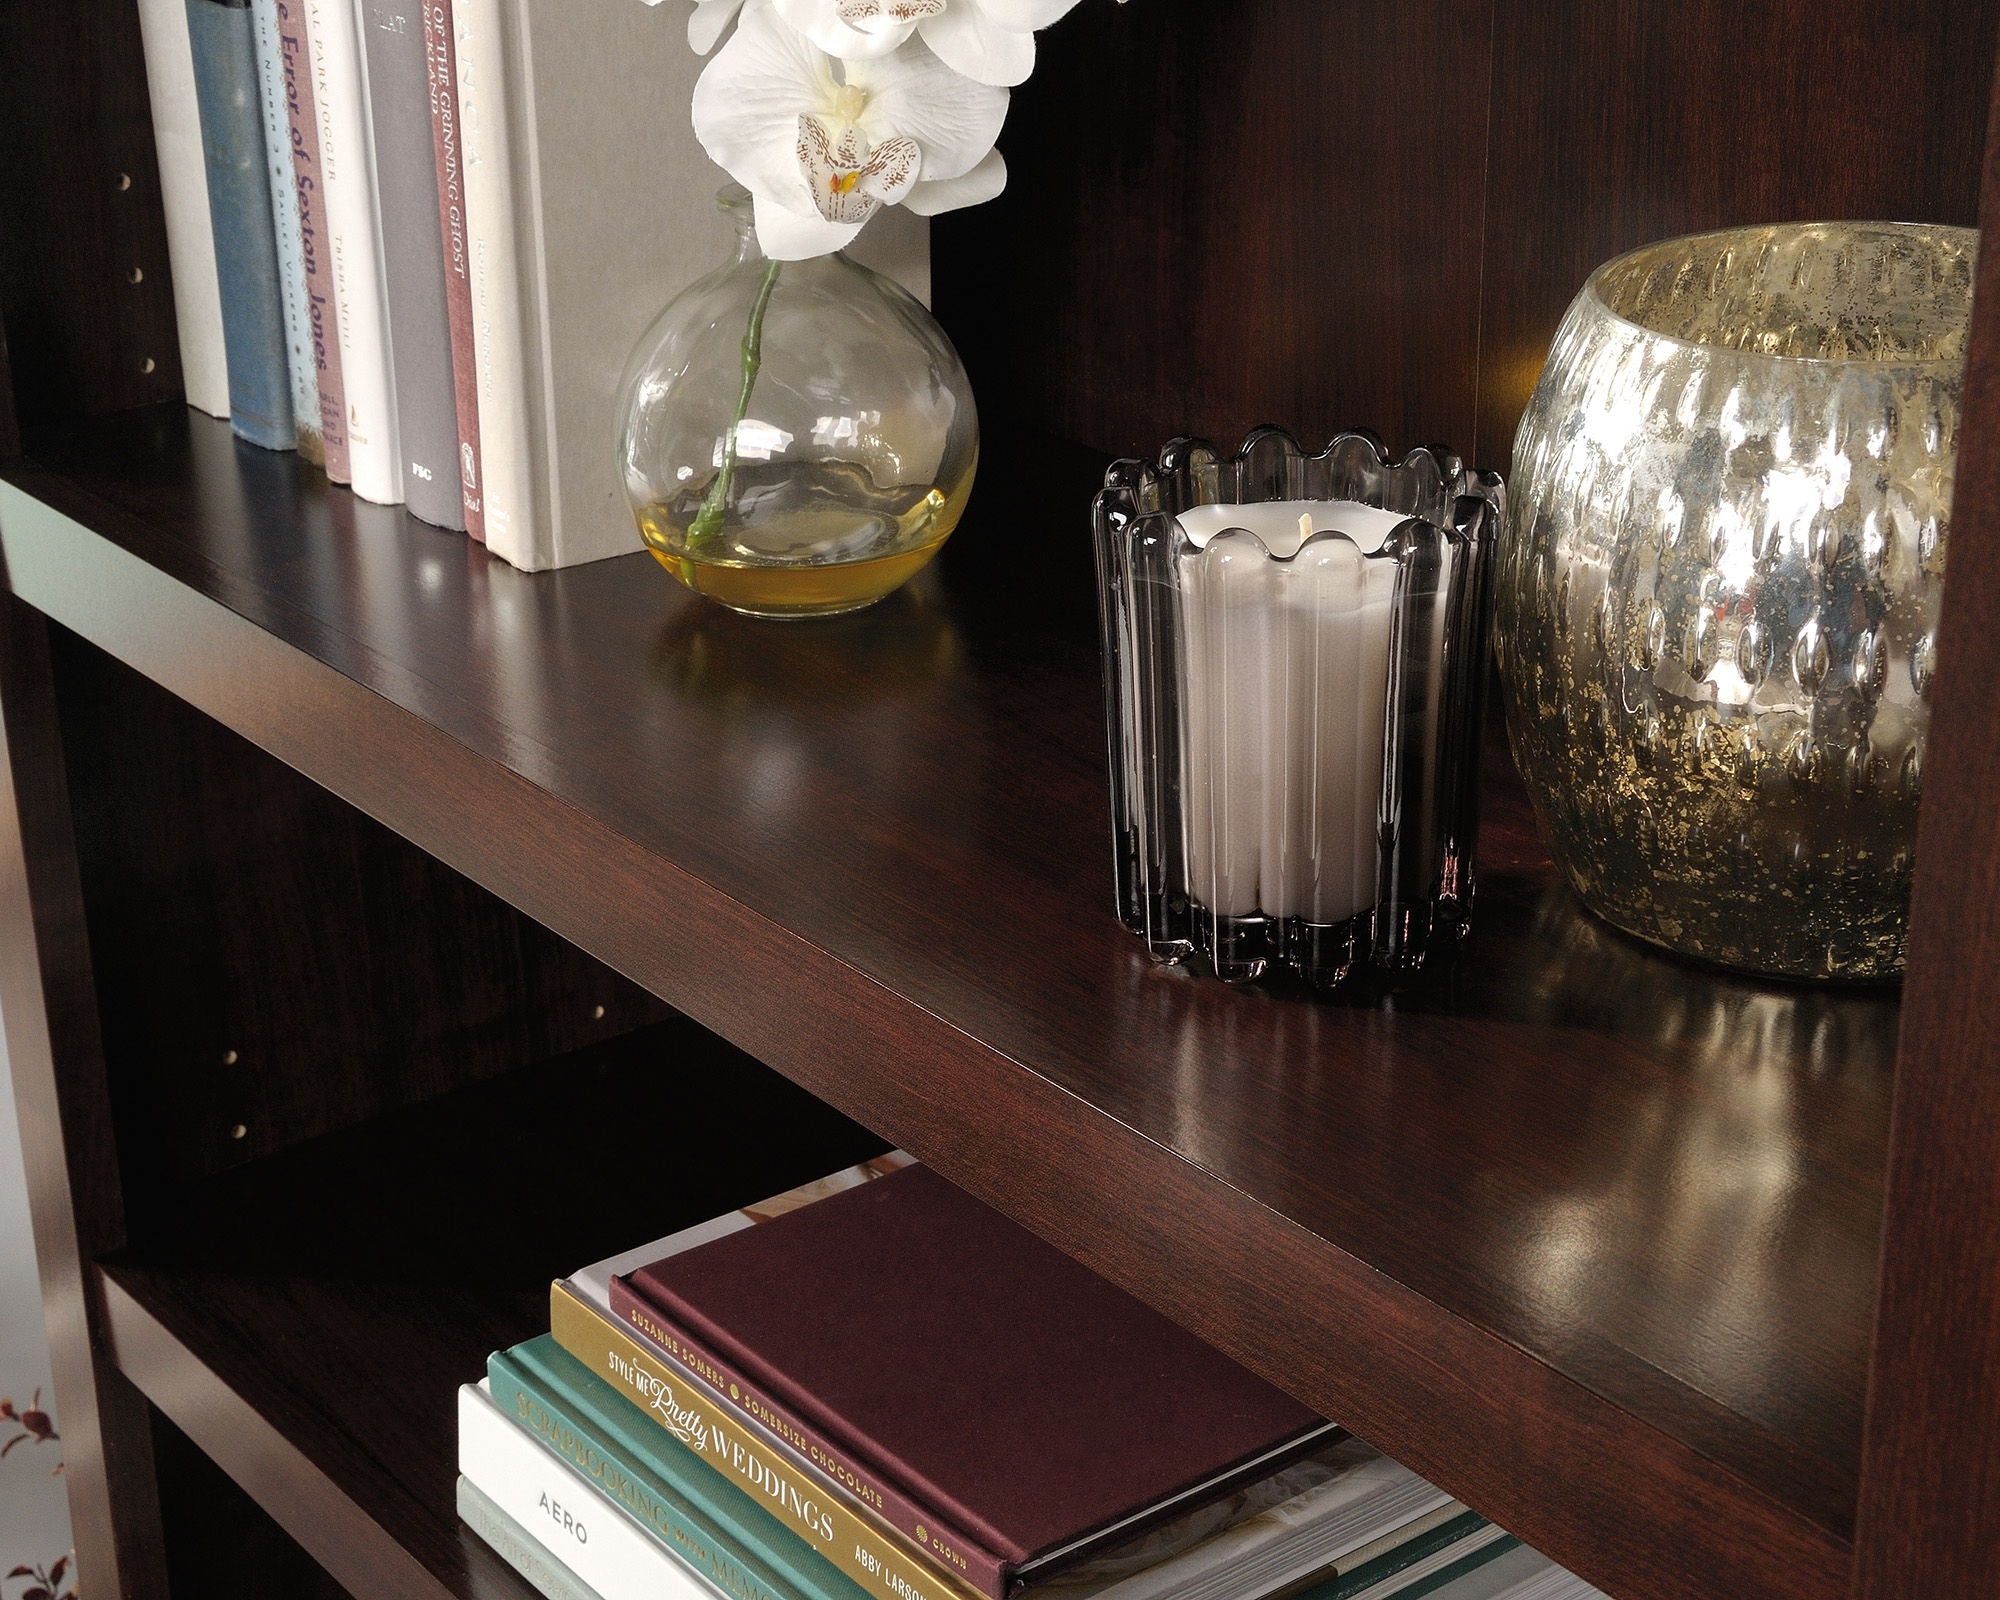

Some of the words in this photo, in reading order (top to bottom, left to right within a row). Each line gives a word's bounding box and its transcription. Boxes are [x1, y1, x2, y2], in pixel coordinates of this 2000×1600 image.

[281, 35, 300, 115] Error
[315, 39, 328, 92] PARK
[423, 0, 438, 115] RICKLAND
[437, 40, 449, 87] THE
[264, 59, 276, 132] NUMBER
[292, 127, 311, 162] of
[320, 99, 336, 180] JOGGER
[440, 91, 459, 200] GRINNING
[296, 174, 317, 275] Sexton
[449, 205, 465, 279] GHOST
[308, 287, 328, 371] Jones
[463, 490, 480, 512] Dial
[608, 1351, 634, 1385] STYLE
[632, 1357, 708, 1452] Pretty
[636, 1372, 649, 1397] ME
[631, 1309, 679, 1354] SUZANNE
[682, 1347, 725, 1389] SOMERS
[744, 1394, 807, 1451] SOMERSIZE
[810, 1446, 884, 1508] CHOCOLATE
[516, 1391, 669, 1537] SCRAPBOOKING
[711, 1425, 834, 1542] WEDDINGS
[539, 1491, 588, 1544] AERO
[932, 1538, 968, 1570] CROWN
[855, 1544, 881, 1577] ABBY
